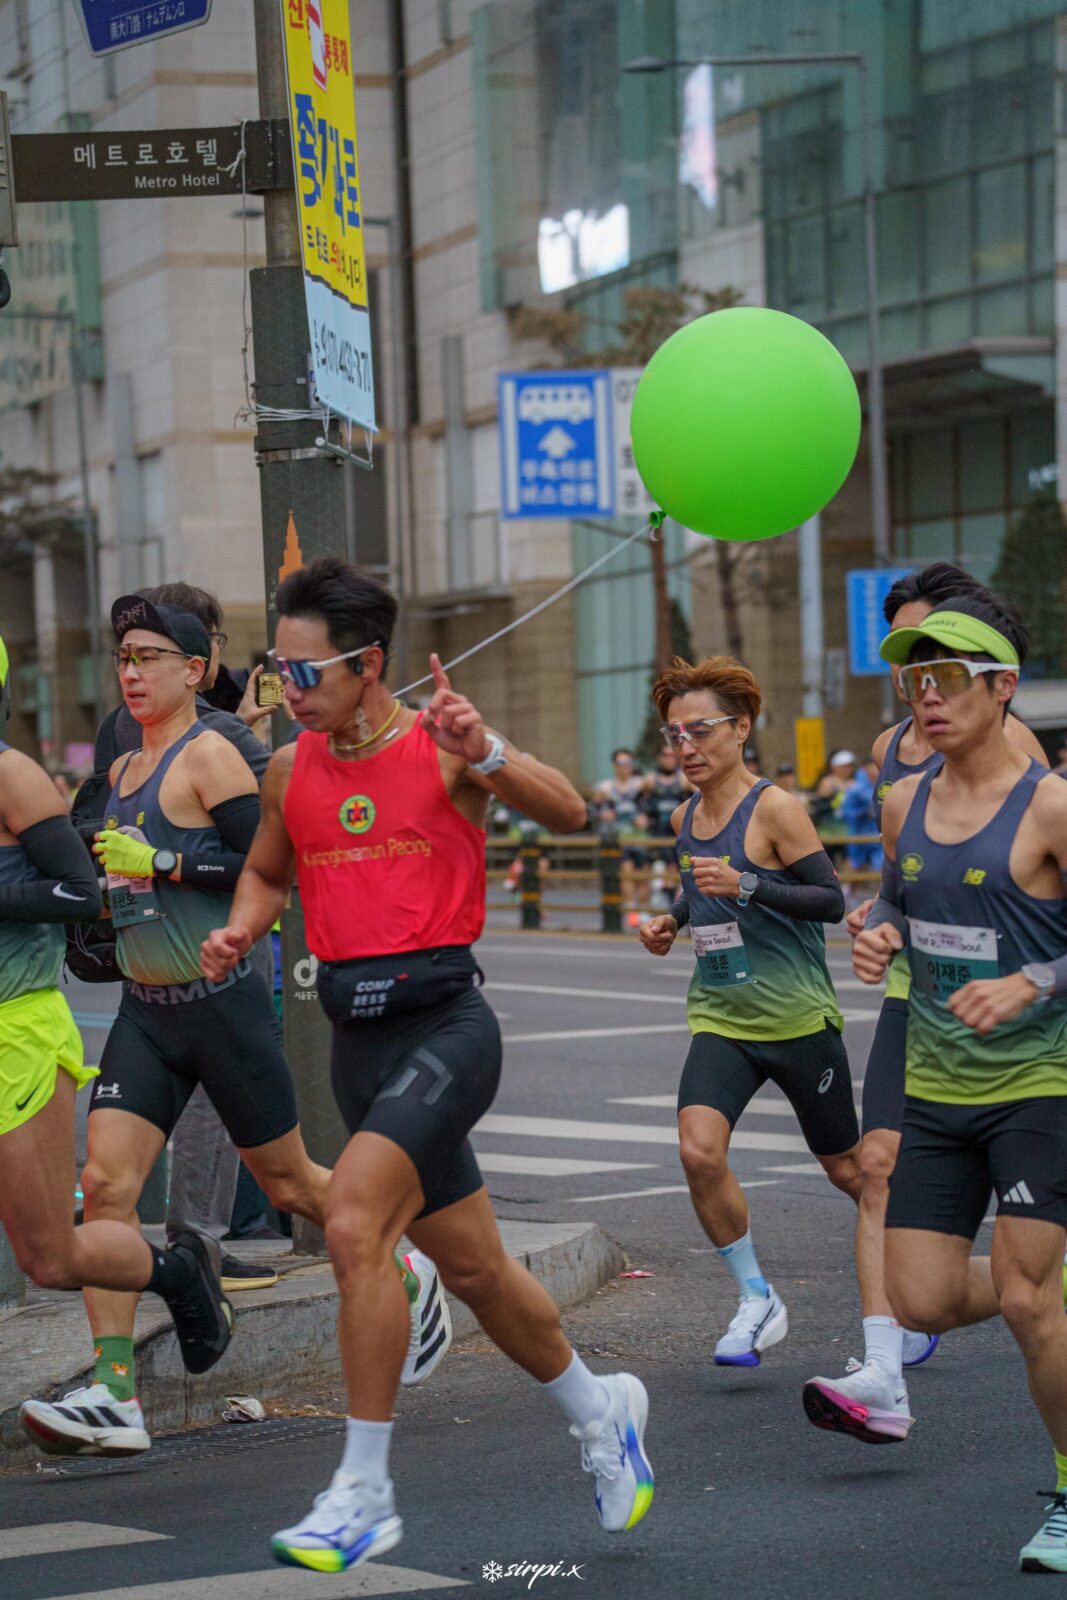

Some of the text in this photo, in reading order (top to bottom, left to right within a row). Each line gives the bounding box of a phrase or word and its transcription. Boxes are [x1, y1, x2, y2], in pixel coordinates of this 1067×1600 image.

[73, 138, 218, 170] 메트로호텔
[135, 173, 220, 189] Metro Hotel
[387, 838, 432, 857] Pacing
[927, 961, 971, 983] 이재준
[355, 978, 395, 993] COMP
